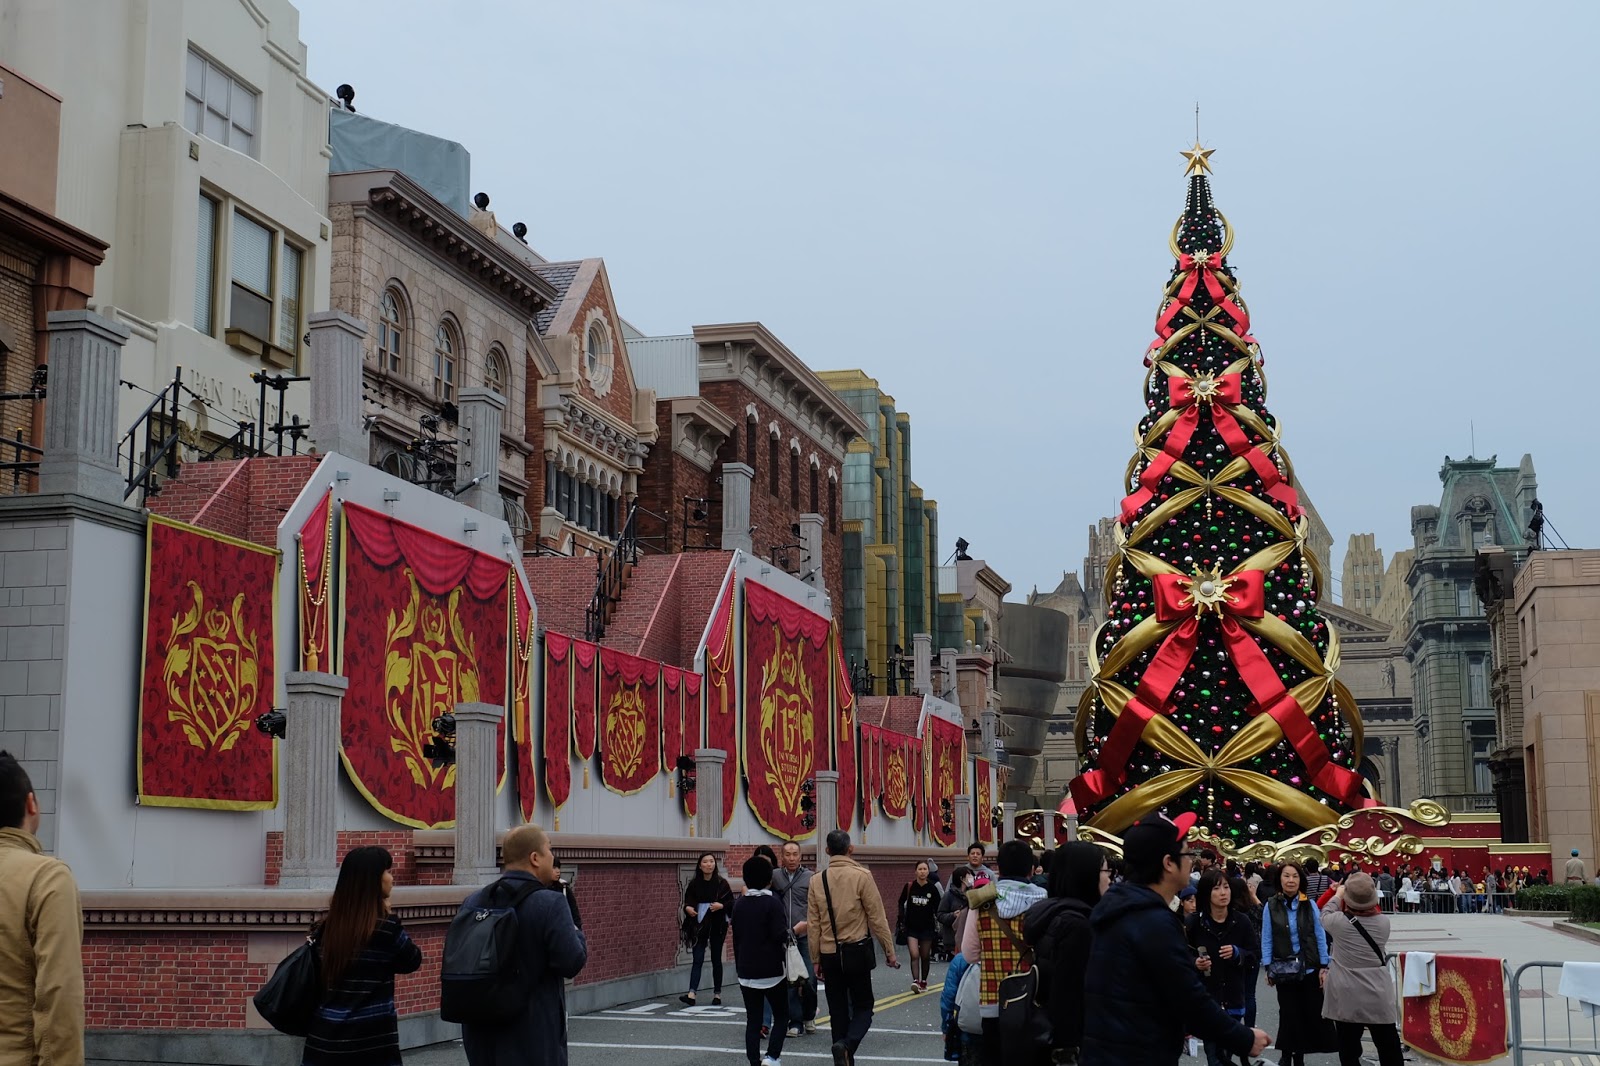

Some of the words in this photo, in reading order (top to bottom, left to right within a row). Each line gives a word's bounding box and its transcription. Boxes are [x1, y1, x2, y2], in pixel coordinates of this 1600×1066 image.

[190, 368, 223, 406] PAN
[231, 387, 291, 429] PACFI
[1440, 1005, 1467, 1013] UNIVERSAL
